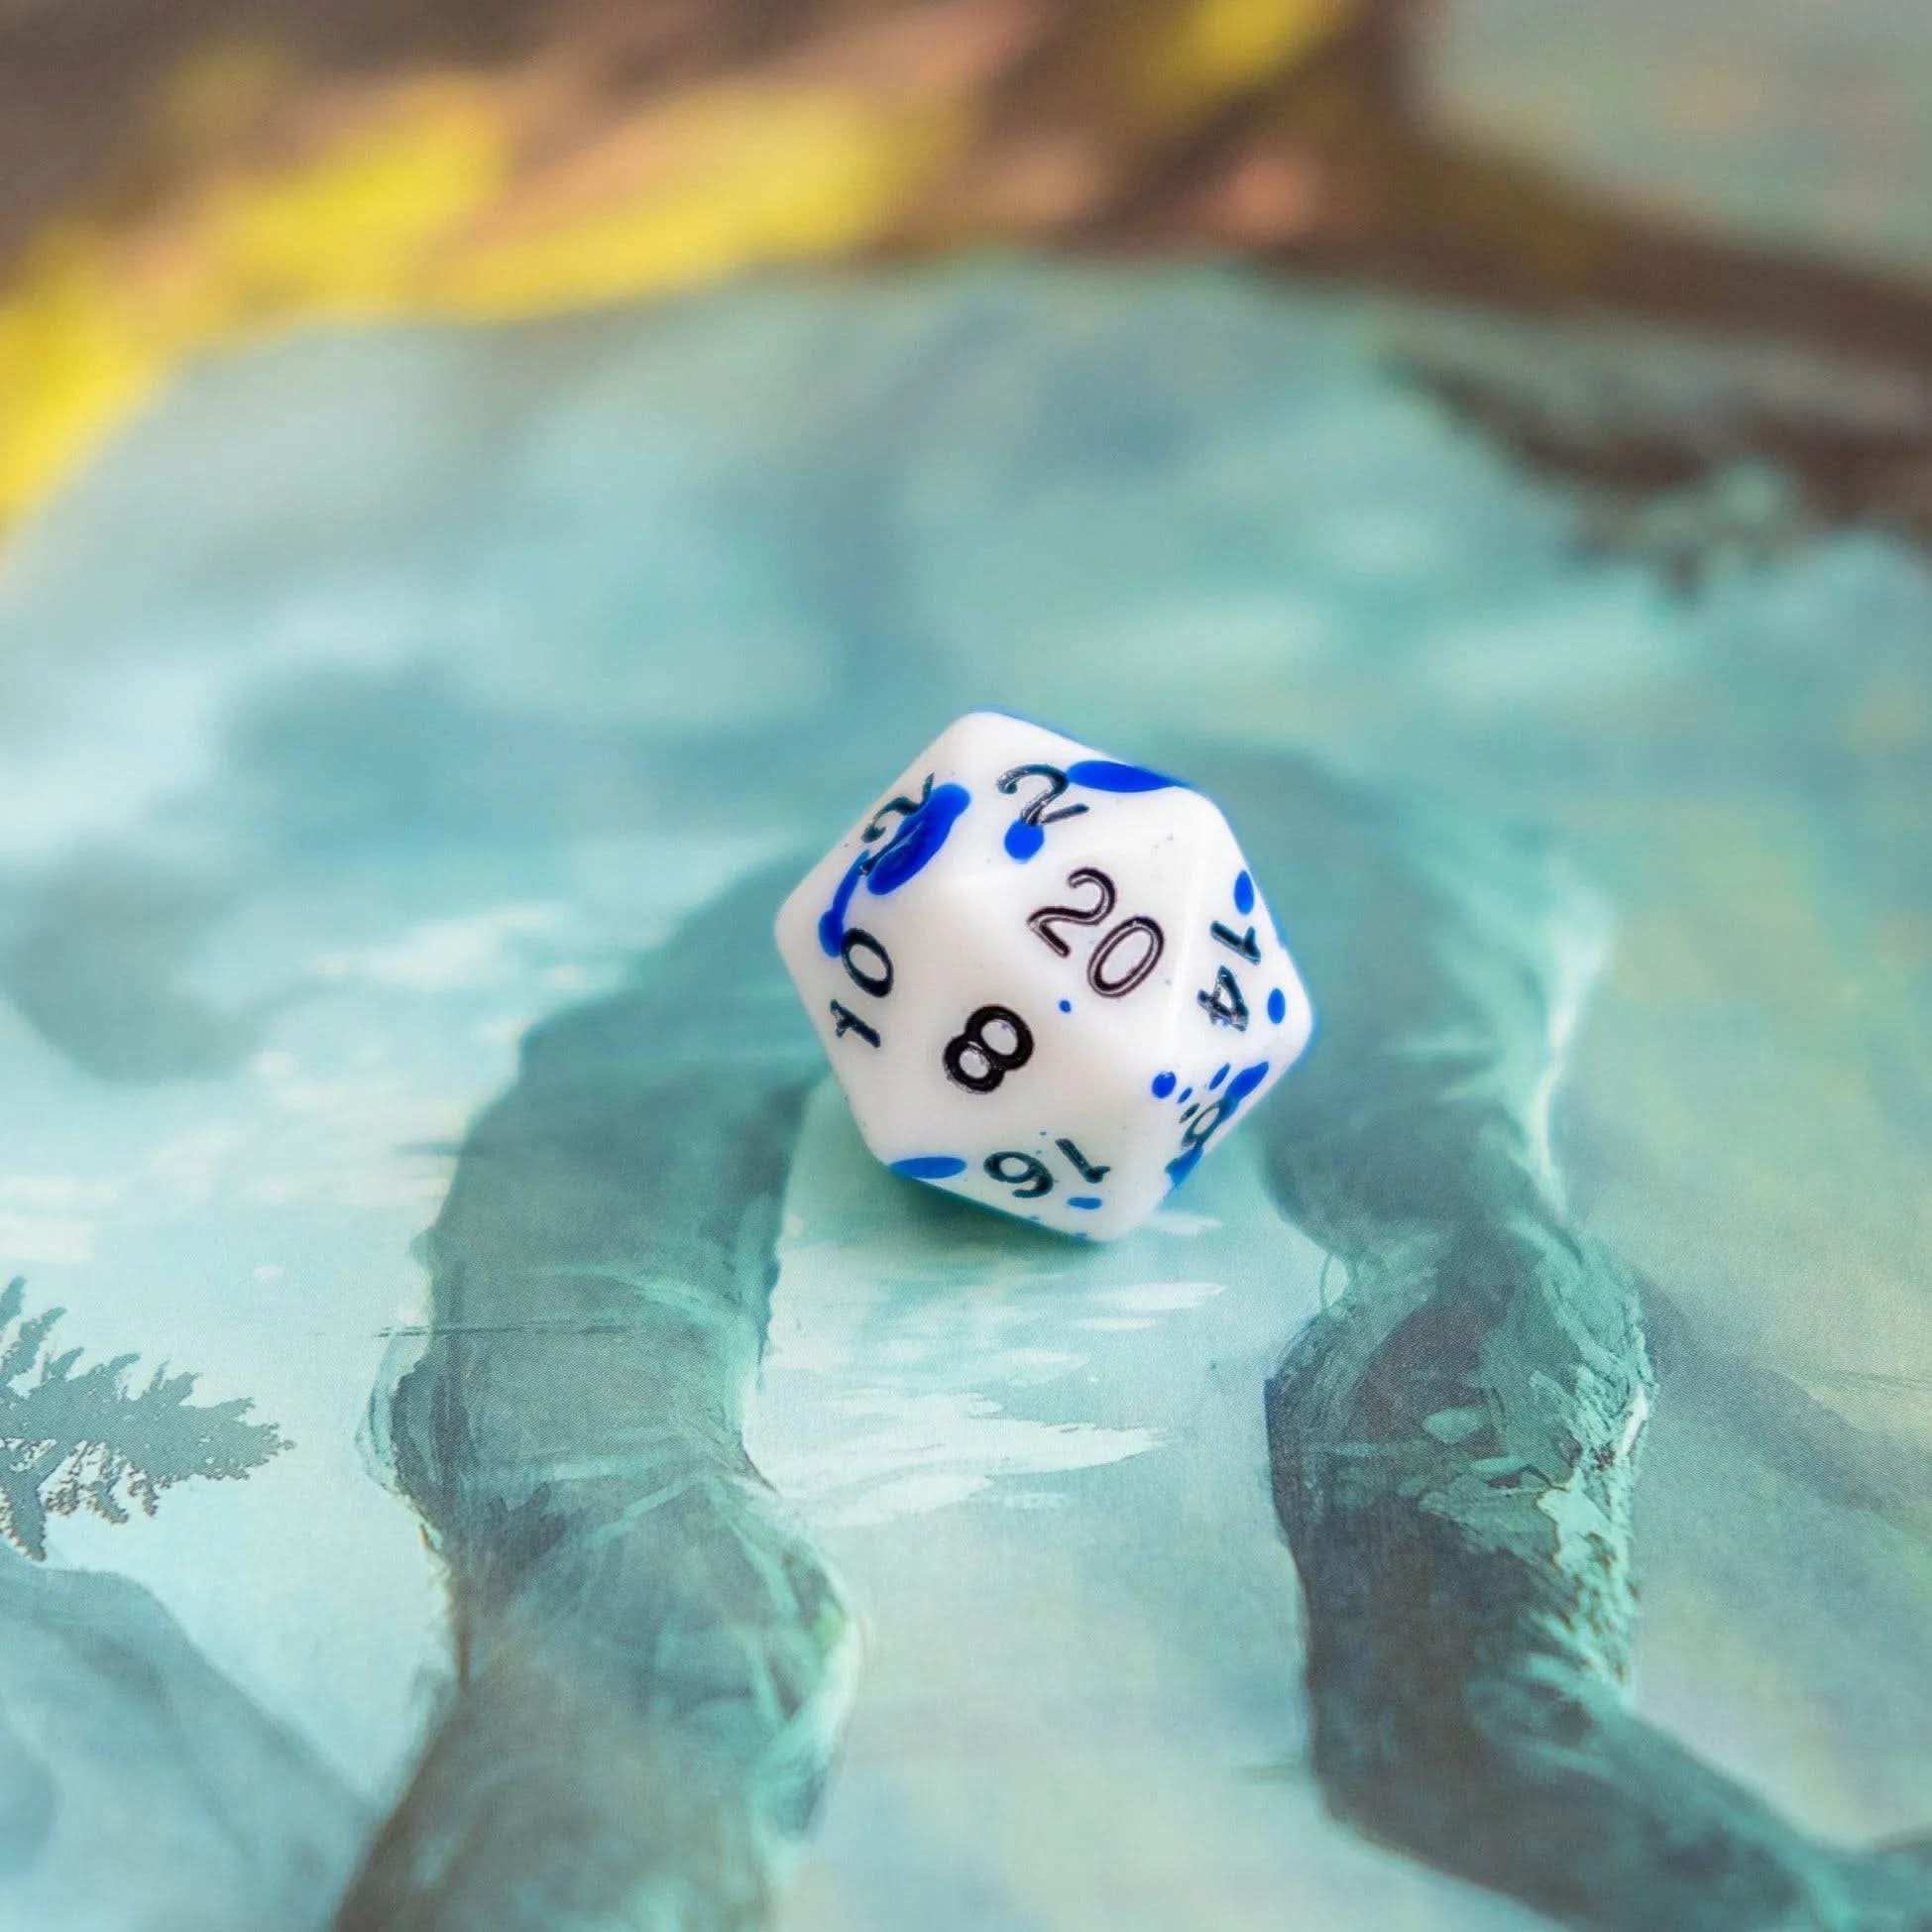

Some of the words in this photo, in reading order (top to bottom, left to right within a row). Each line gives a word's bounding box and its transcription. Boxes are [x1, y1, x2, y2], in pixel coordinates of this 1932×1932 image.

[995, 763, 1089, 827] 2
[1026, 866, 1165, 998] 20
[1196, 920, 1261, 1032] 14
[830, 927, 894, 1048] 10
[943, 1004, 1034, 1094] 8
[982, 1138, 1110, 1198] 16
